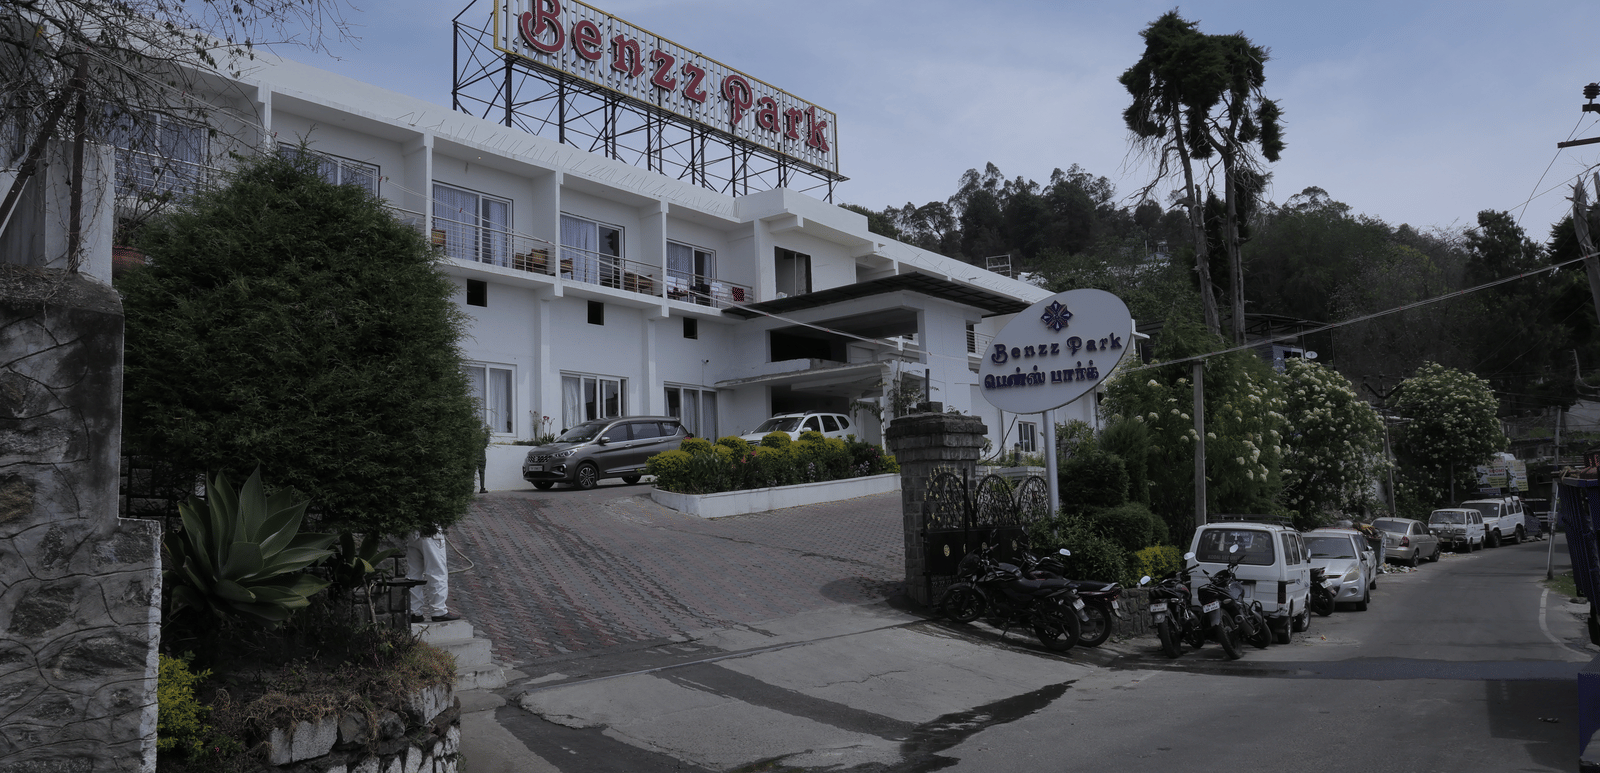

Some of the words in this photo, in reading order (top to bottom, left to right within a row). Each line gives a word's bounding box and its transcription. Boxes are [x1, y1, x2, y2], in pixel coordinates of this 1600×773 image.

[518, 0, 707, 103] Benzz
[721, 74, 830, 153] Park
[991, 343, 1060, 365] Benzz
[1066, 332, 1122, 356] Park
[1050, 359, 1099, 384] பார்க்
